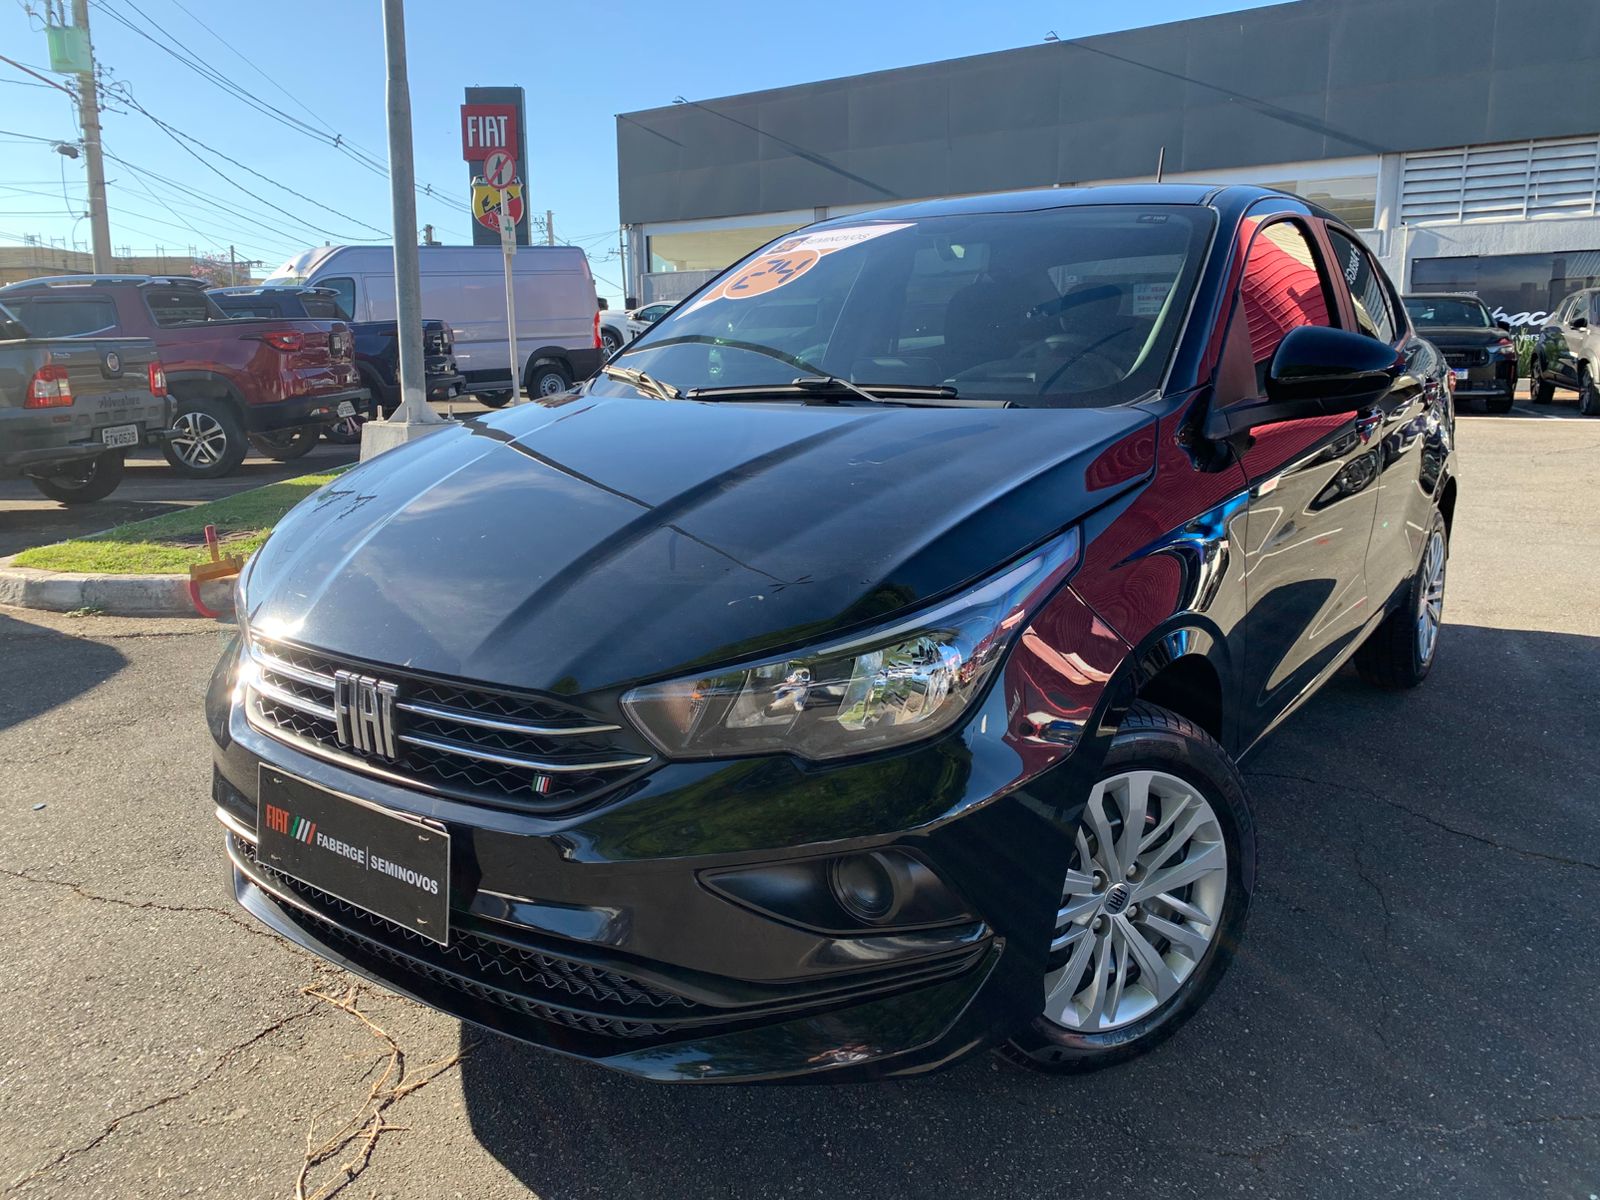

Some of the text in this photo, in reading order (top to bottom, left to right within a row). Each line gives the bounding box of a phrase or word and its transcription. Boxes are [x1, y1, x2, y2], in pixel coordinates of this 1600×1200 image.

[467, 116, 508, 147] FIAT
[335, 670, 398, 758] FIAT
[266, 804, 438, 894] FIAT FABERGE SEMINOVOS
[1109, 888, 1127, 910] FIAT
